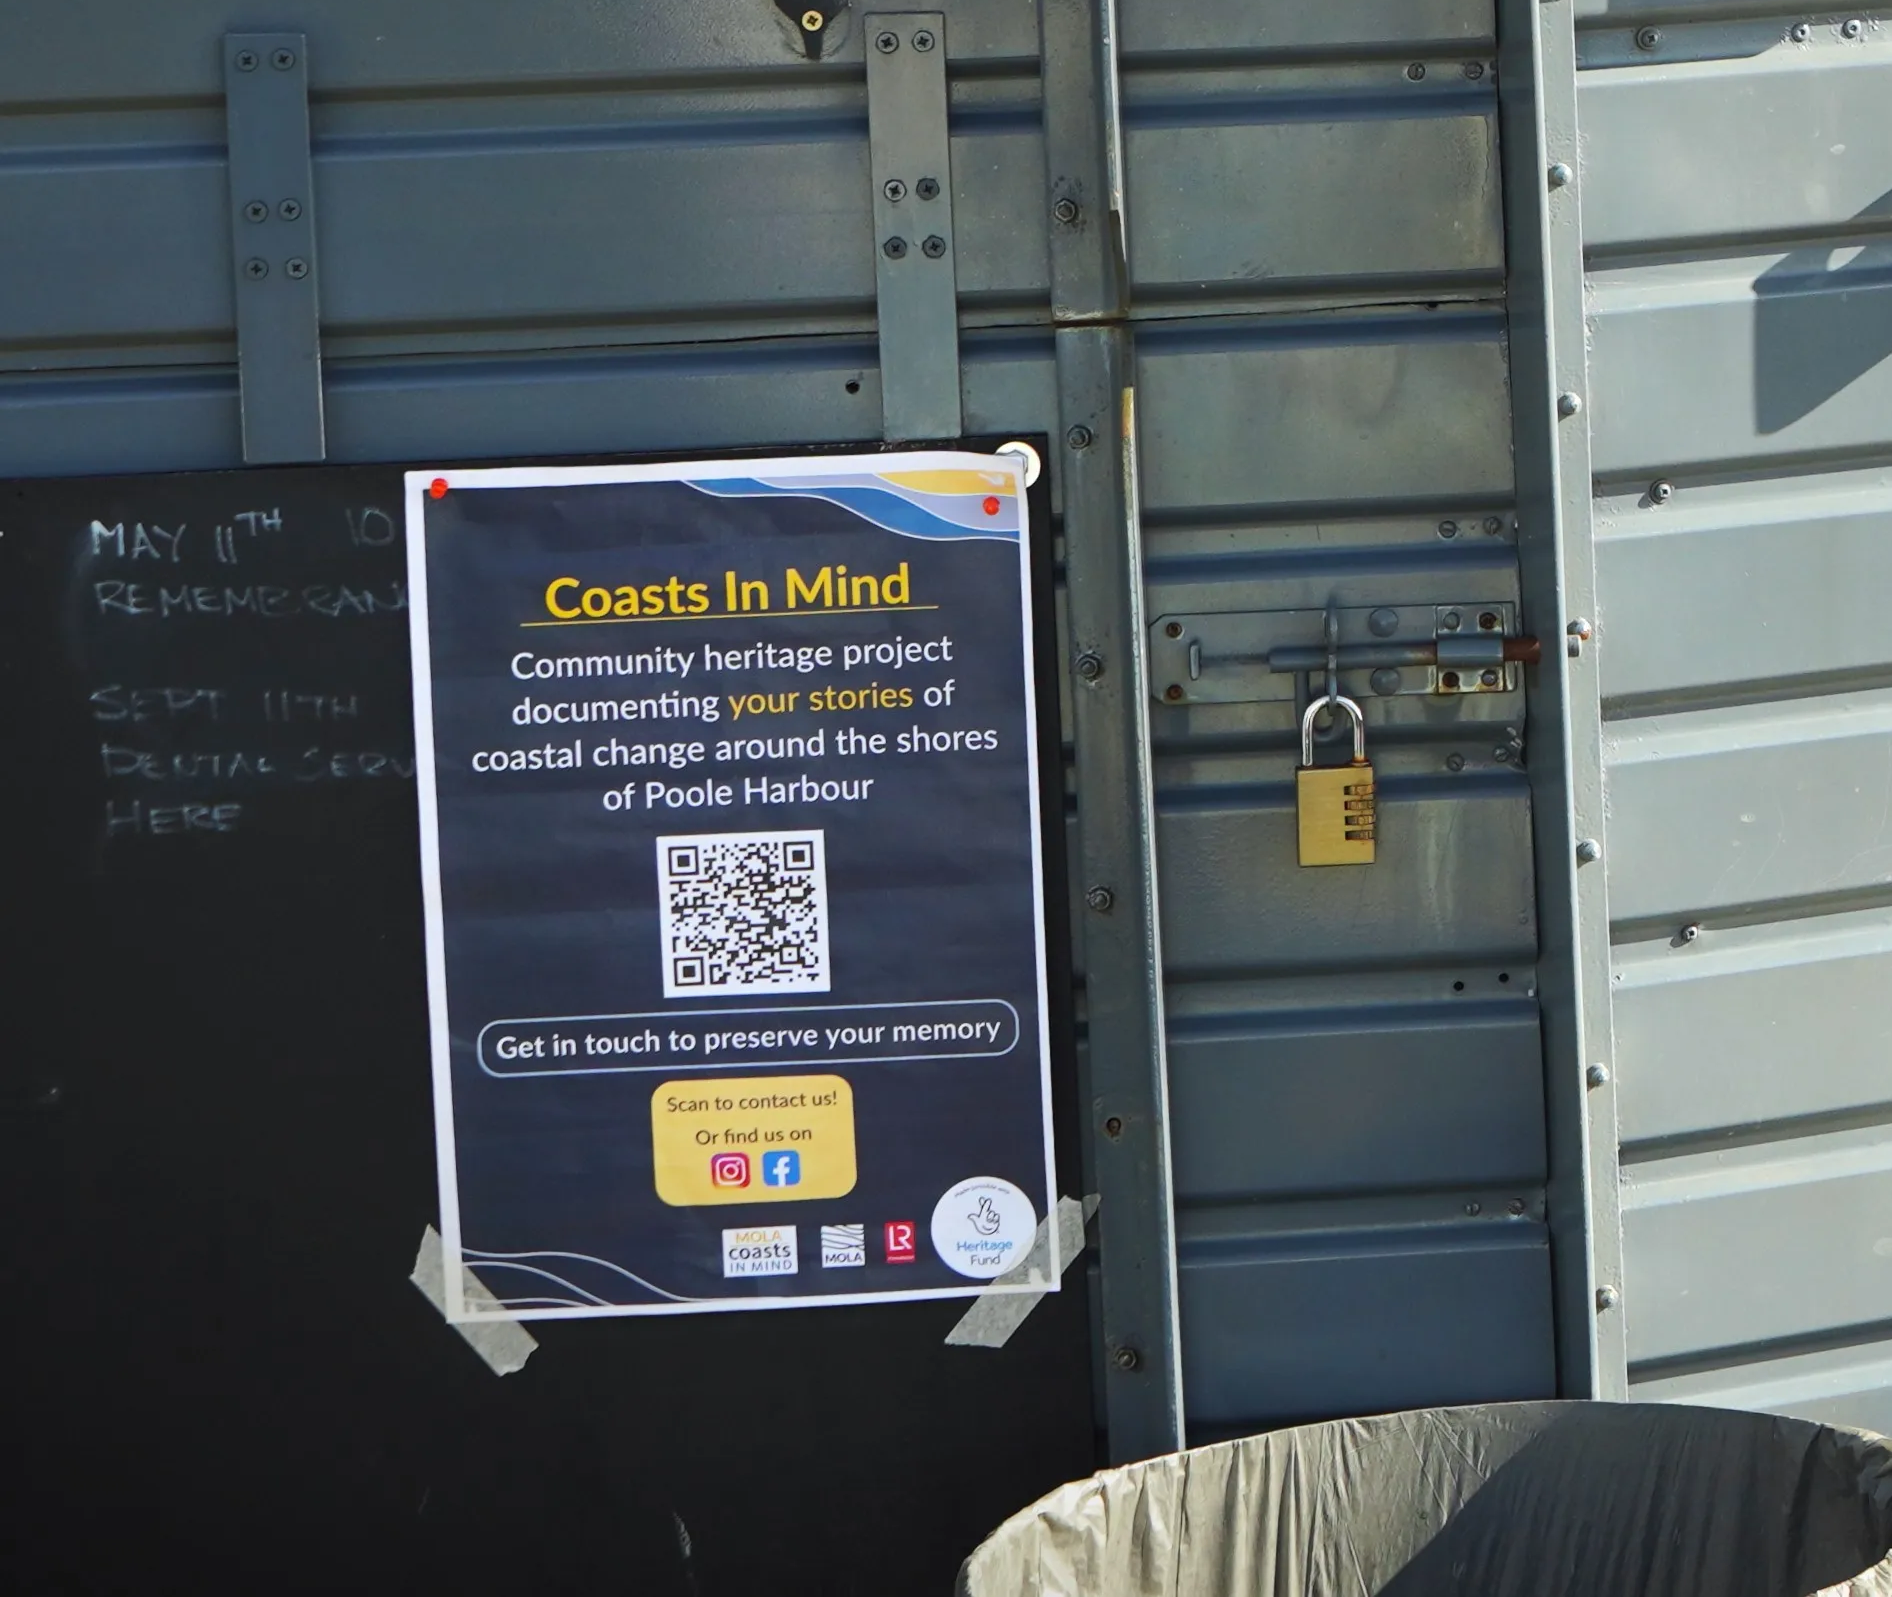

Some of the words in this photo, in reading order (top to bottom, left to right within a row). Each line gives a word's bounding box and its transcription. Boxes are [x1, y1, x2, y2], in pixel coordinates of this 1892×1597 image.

[89, 518, 188, 564] MAY
[545, 575, 711, 620] Coasts
[725, 570, 770, 613] In
[786, 561, 911, 609] Mind
[510, 645, 696, 680] Community
[703, 641, 833, 673] heritage
[843, 635, 954, 670] project
[88, 684, 224, 723] SEPT
[512, 690, 721, 725] documenting
[728, 691, 800, 721] your
[809, 681, 914, 712] stories
[923, 679, 956, 707] of
[471, 739, 583, 772] coastal
[591, 737, 706, 770] change
[715, 728, 826, 761] around
[835, 727, 888, 756] the
[896, 724, 999, 753] shores
[602, 782, 637, 811] of
[644, 777, 734, 810] Poole
[743, 774, 875, 805] Harbour
[106, 799, 243, 838] HERE
[496, 1035, 547, 1060] Get
[551, 1033, 578, 1058] in
[584, 1029, 662, 1055] touch
[667, 1029, 697, 1052] to
[703, 1026, 819, 1055] preserve
[825, 1024, 886, 1051] your
[892, 1019, 1002, 1044] memory
[666, 1095, 710, 1113] Scan
[713, 1095, 735, 1111] to
[738, 1092, 807, 1111] contact
[811, 1090, 839, 1107] us!
[694, 1129, 719, 1147] Or
[722, 1127, 759, 1145] find
[764, 1128, 785, 1144] us
[788, 1127, 813, 1142] on
[728, 1244, 792, 1261] coasts
[734, 1230, 783, 1244] MOLA
[956, 1239, 1014, 1255] Heritage
[729, 1262, 746, 1274] IN
[750, 1259, 793, 1273] MIND
[824, 1252, 864, 1265] MOLA
[969, 1253, 1002, 1266] Fund
